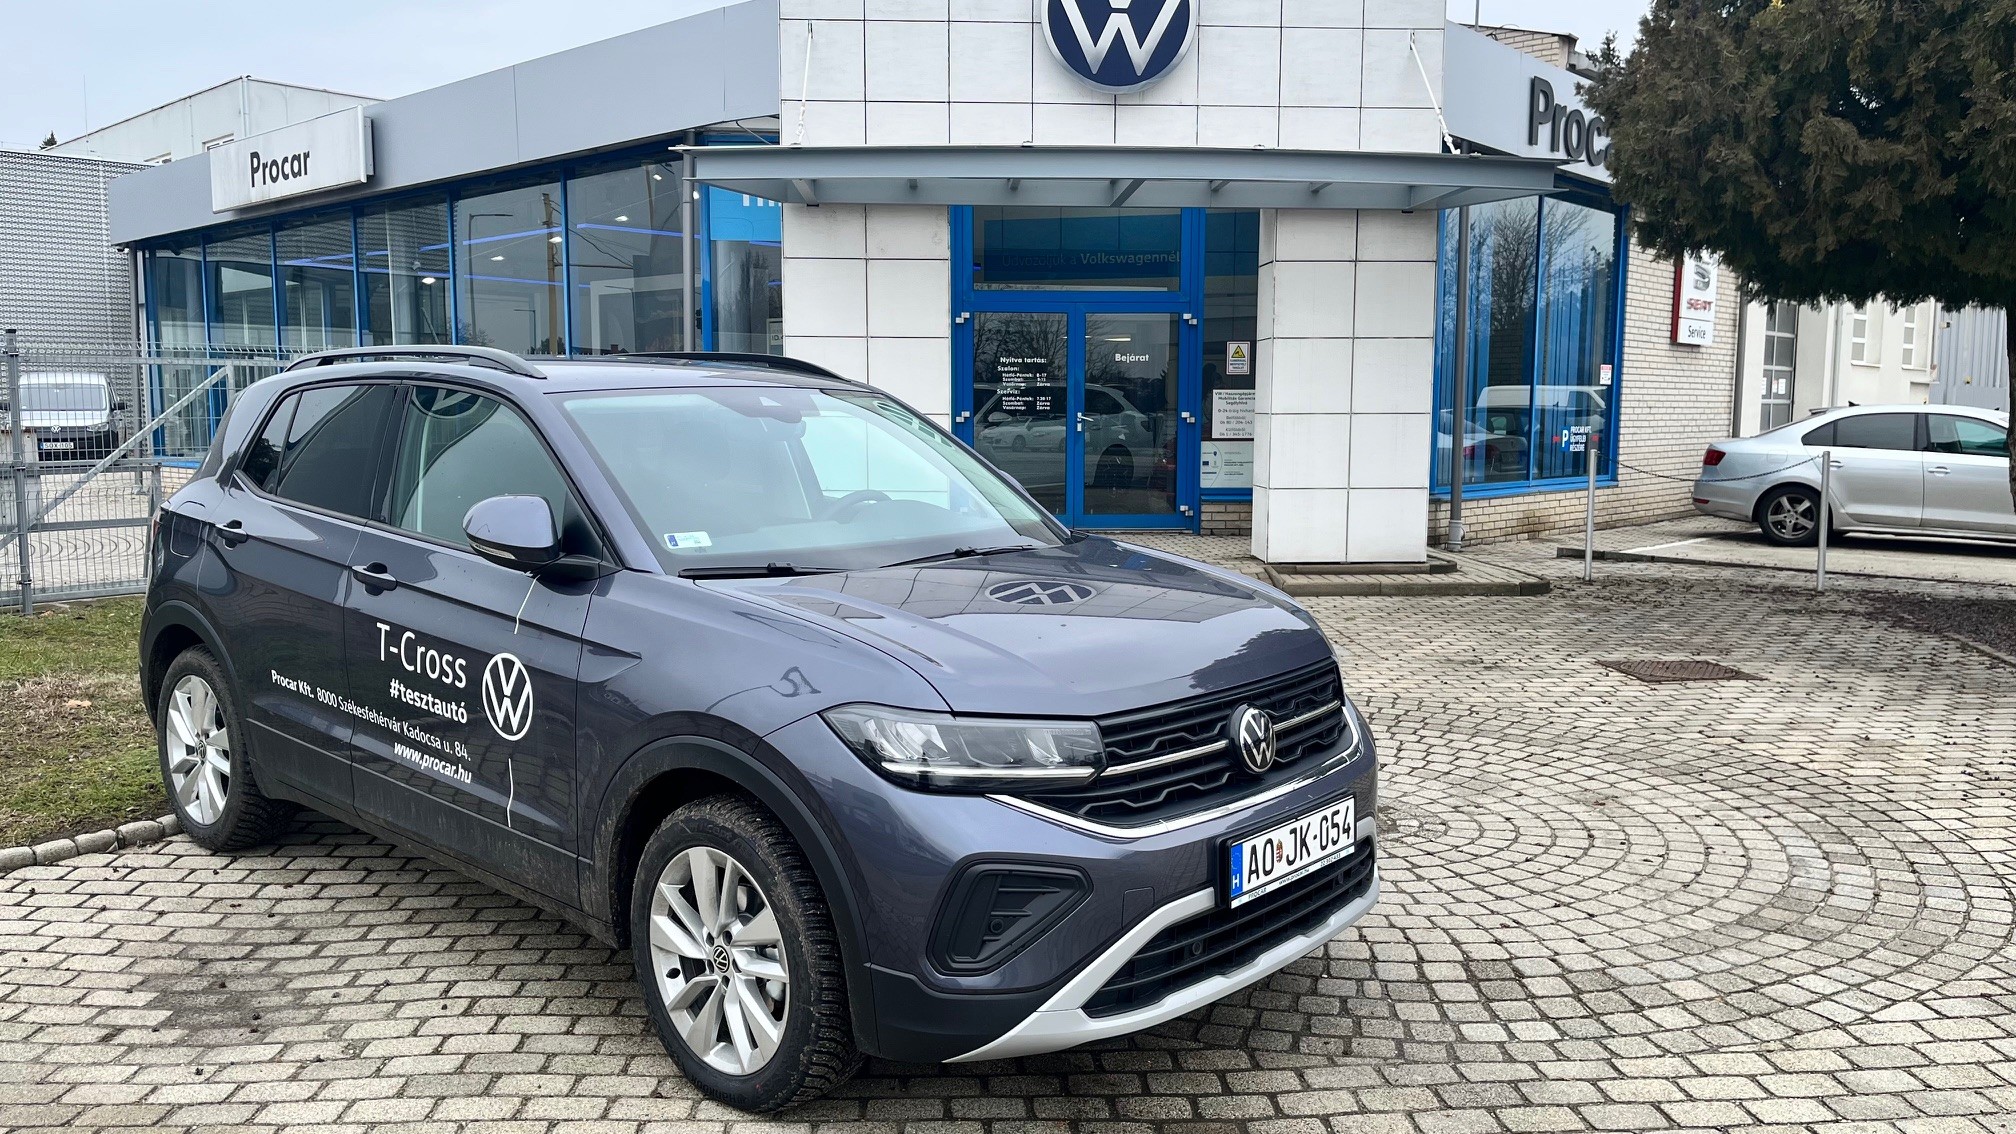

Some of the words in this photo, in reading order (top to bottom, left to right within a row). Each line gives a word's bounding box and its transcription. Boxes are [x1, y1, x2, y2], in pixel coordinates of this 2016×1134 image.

[250, 151, 310, 188] Procar
[1080, 251, 1180, 266] Volkswagennél
[1687, 298, 1714, 312] SEAT
[1688, 325, 1706, 339] Service
[1000, 356, 1023, 364] Nyitva
[1115, 353, 1149, 363] Bejárat
[1561, 429, 1569, 448] P
[376, 622, 467, 689] T-Cross
[390, 678, 467, 724] #tesztautó
[271, 669, 297, 692] Procar
[298, 679, 315, 699] Kft.
[316, 687, 337, 708] 8000
[338, 695, 401, 733] Székesfehérvár
[402, 723, 441, 750] Kadocsa
[443, 740, 453, 754] u.
[454, 743, 471, 761] 84.
[393, 741, 472, 784] www.procar.hu
[1247, 837, 1275, 884] AO
[1286, 805, 1351, 867] JK-054
[1232, 873, 1240, 890] H
